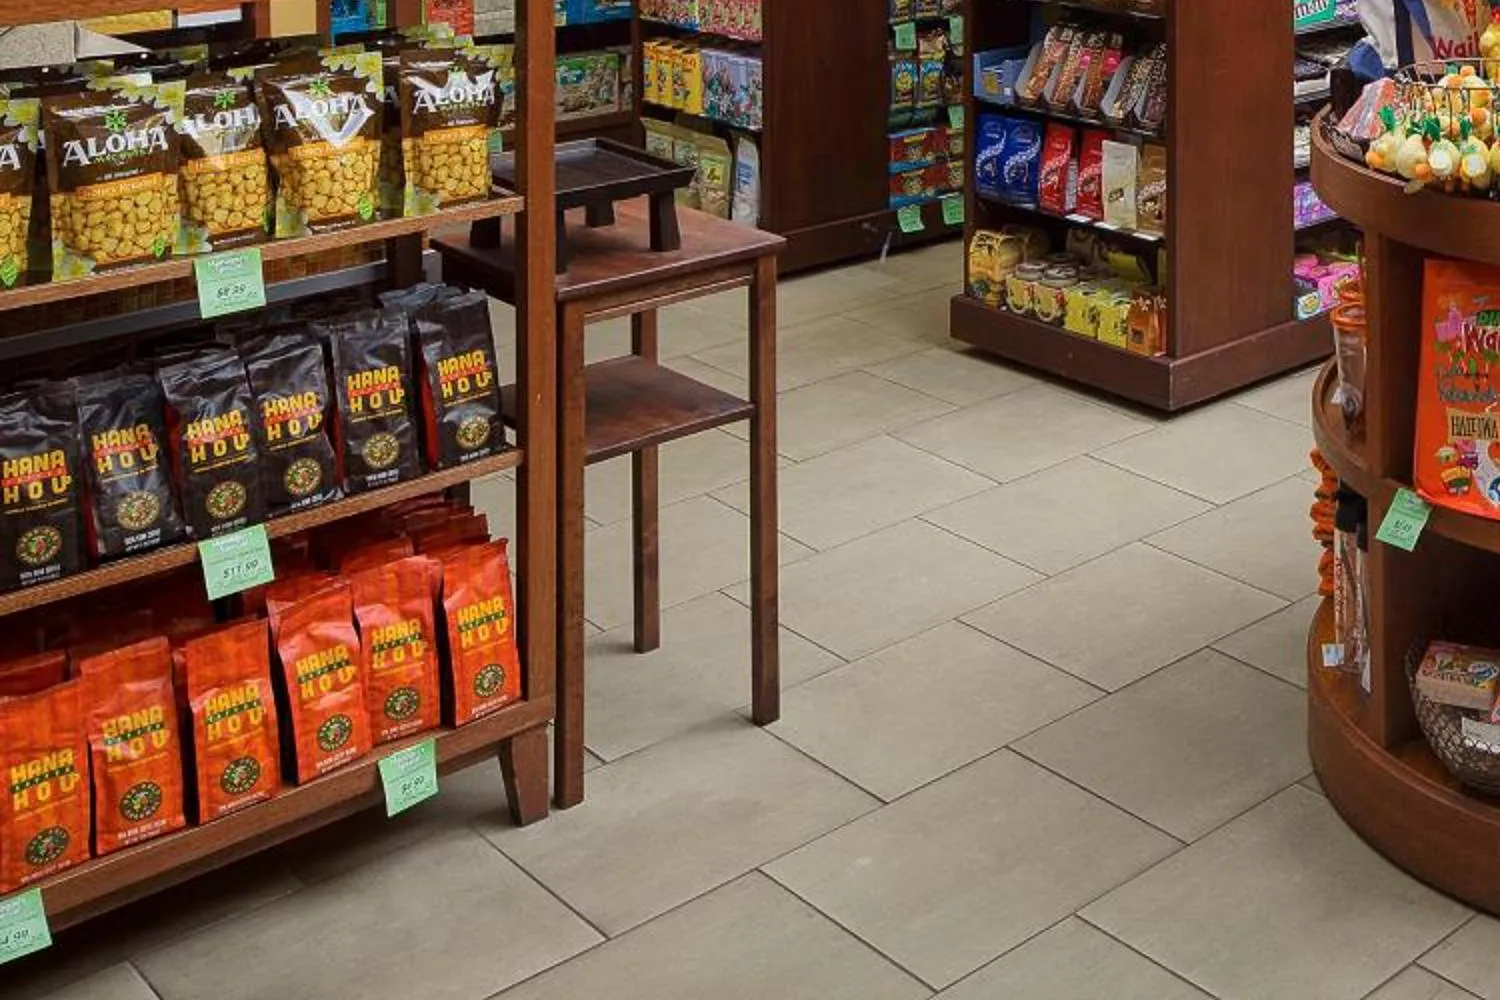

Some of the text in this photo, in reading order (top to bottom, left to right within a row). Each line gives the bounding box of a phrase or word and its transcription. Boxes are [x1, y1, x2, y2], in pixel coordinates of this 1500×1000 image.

[63, 126, 169, 168] ALOHA
[438, 350, 485, 374] HANA
[348, 366, 400, 390] HANA
[264, 391, 318, 417] HANA
[93, 423, 149, 450] HANA
[187, 409, 243, 438] HANA
[3, 450, 65, 477] HANA
[458, 597, 503, 622] HANA
[371, 618, 422, 643] HANA
[296, 644, 350, 676] HANA
[205, 682, 260, 713] HANA
[102, 705, 164, 738] HANA
[10, 748, 74, 783] HANA
